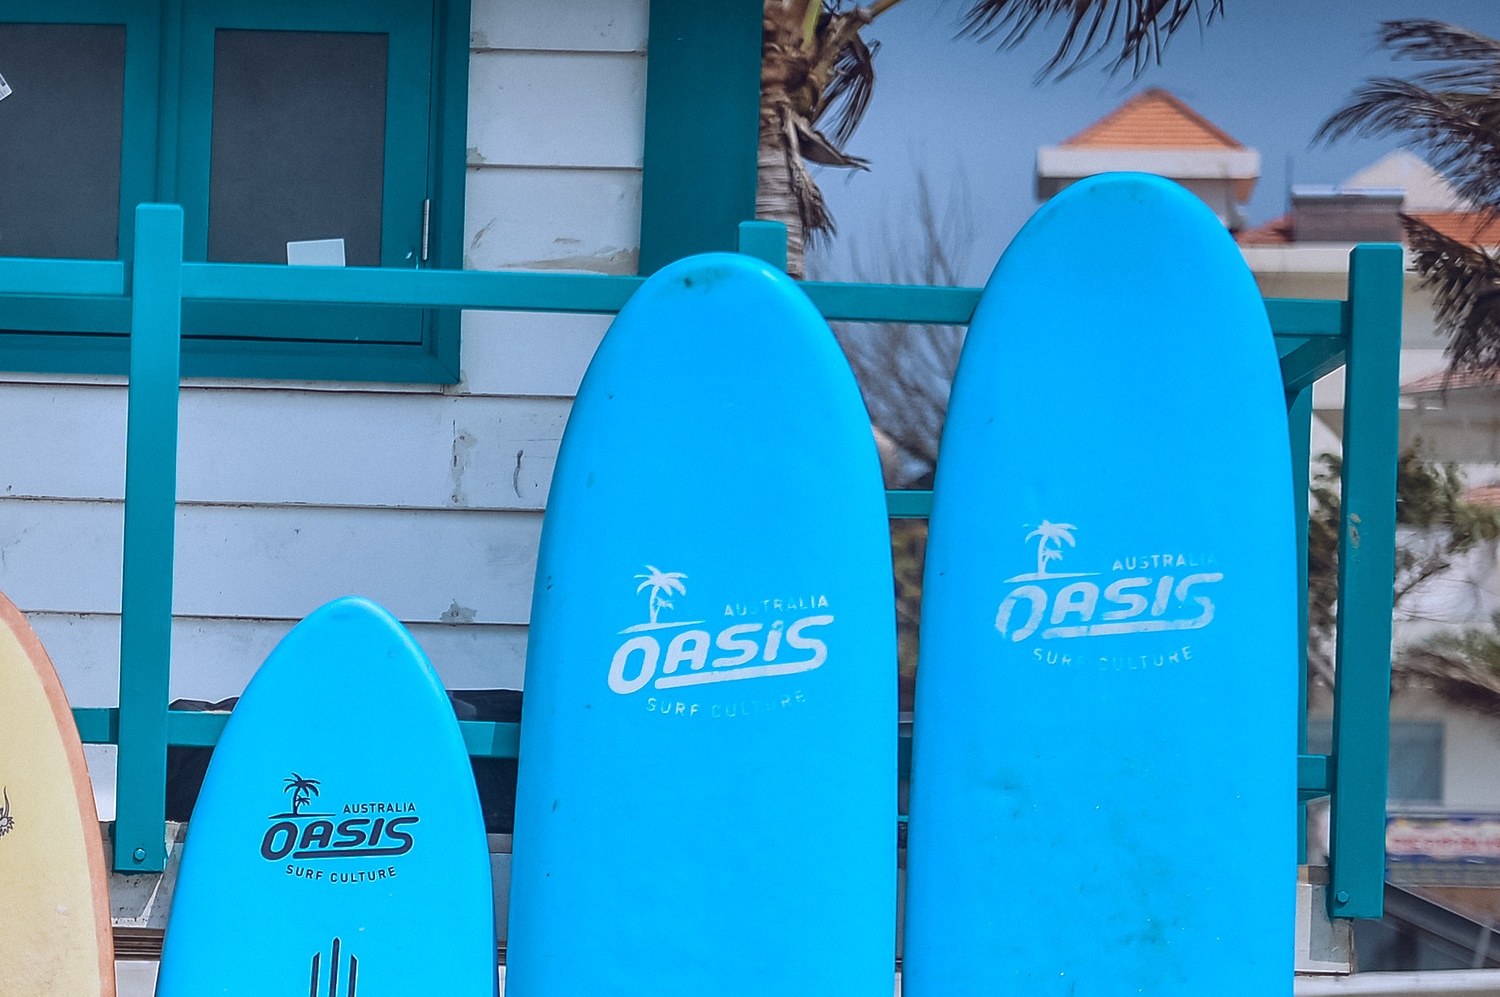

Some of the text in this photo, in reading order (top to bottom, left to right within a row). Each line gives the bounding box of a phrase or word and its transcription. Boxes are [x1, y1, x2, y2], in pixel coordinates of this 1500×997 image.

[1112, 552, 1217, 571] AUSTRAL
[724, 595, 829, 617] AUTRALIA
[995, 572, 1224, 643] OASIS
[607, 615, 835, 695] OASIS
[1033, 648, 1083, 669] SUR
[647, 690, 807, 718] SURF CULRE
[343, 802, 417, 814] AUSTRALIA
[260, 816, 420, 861] OASIS
[286, 864, 397, 883] SURF CULTURE
